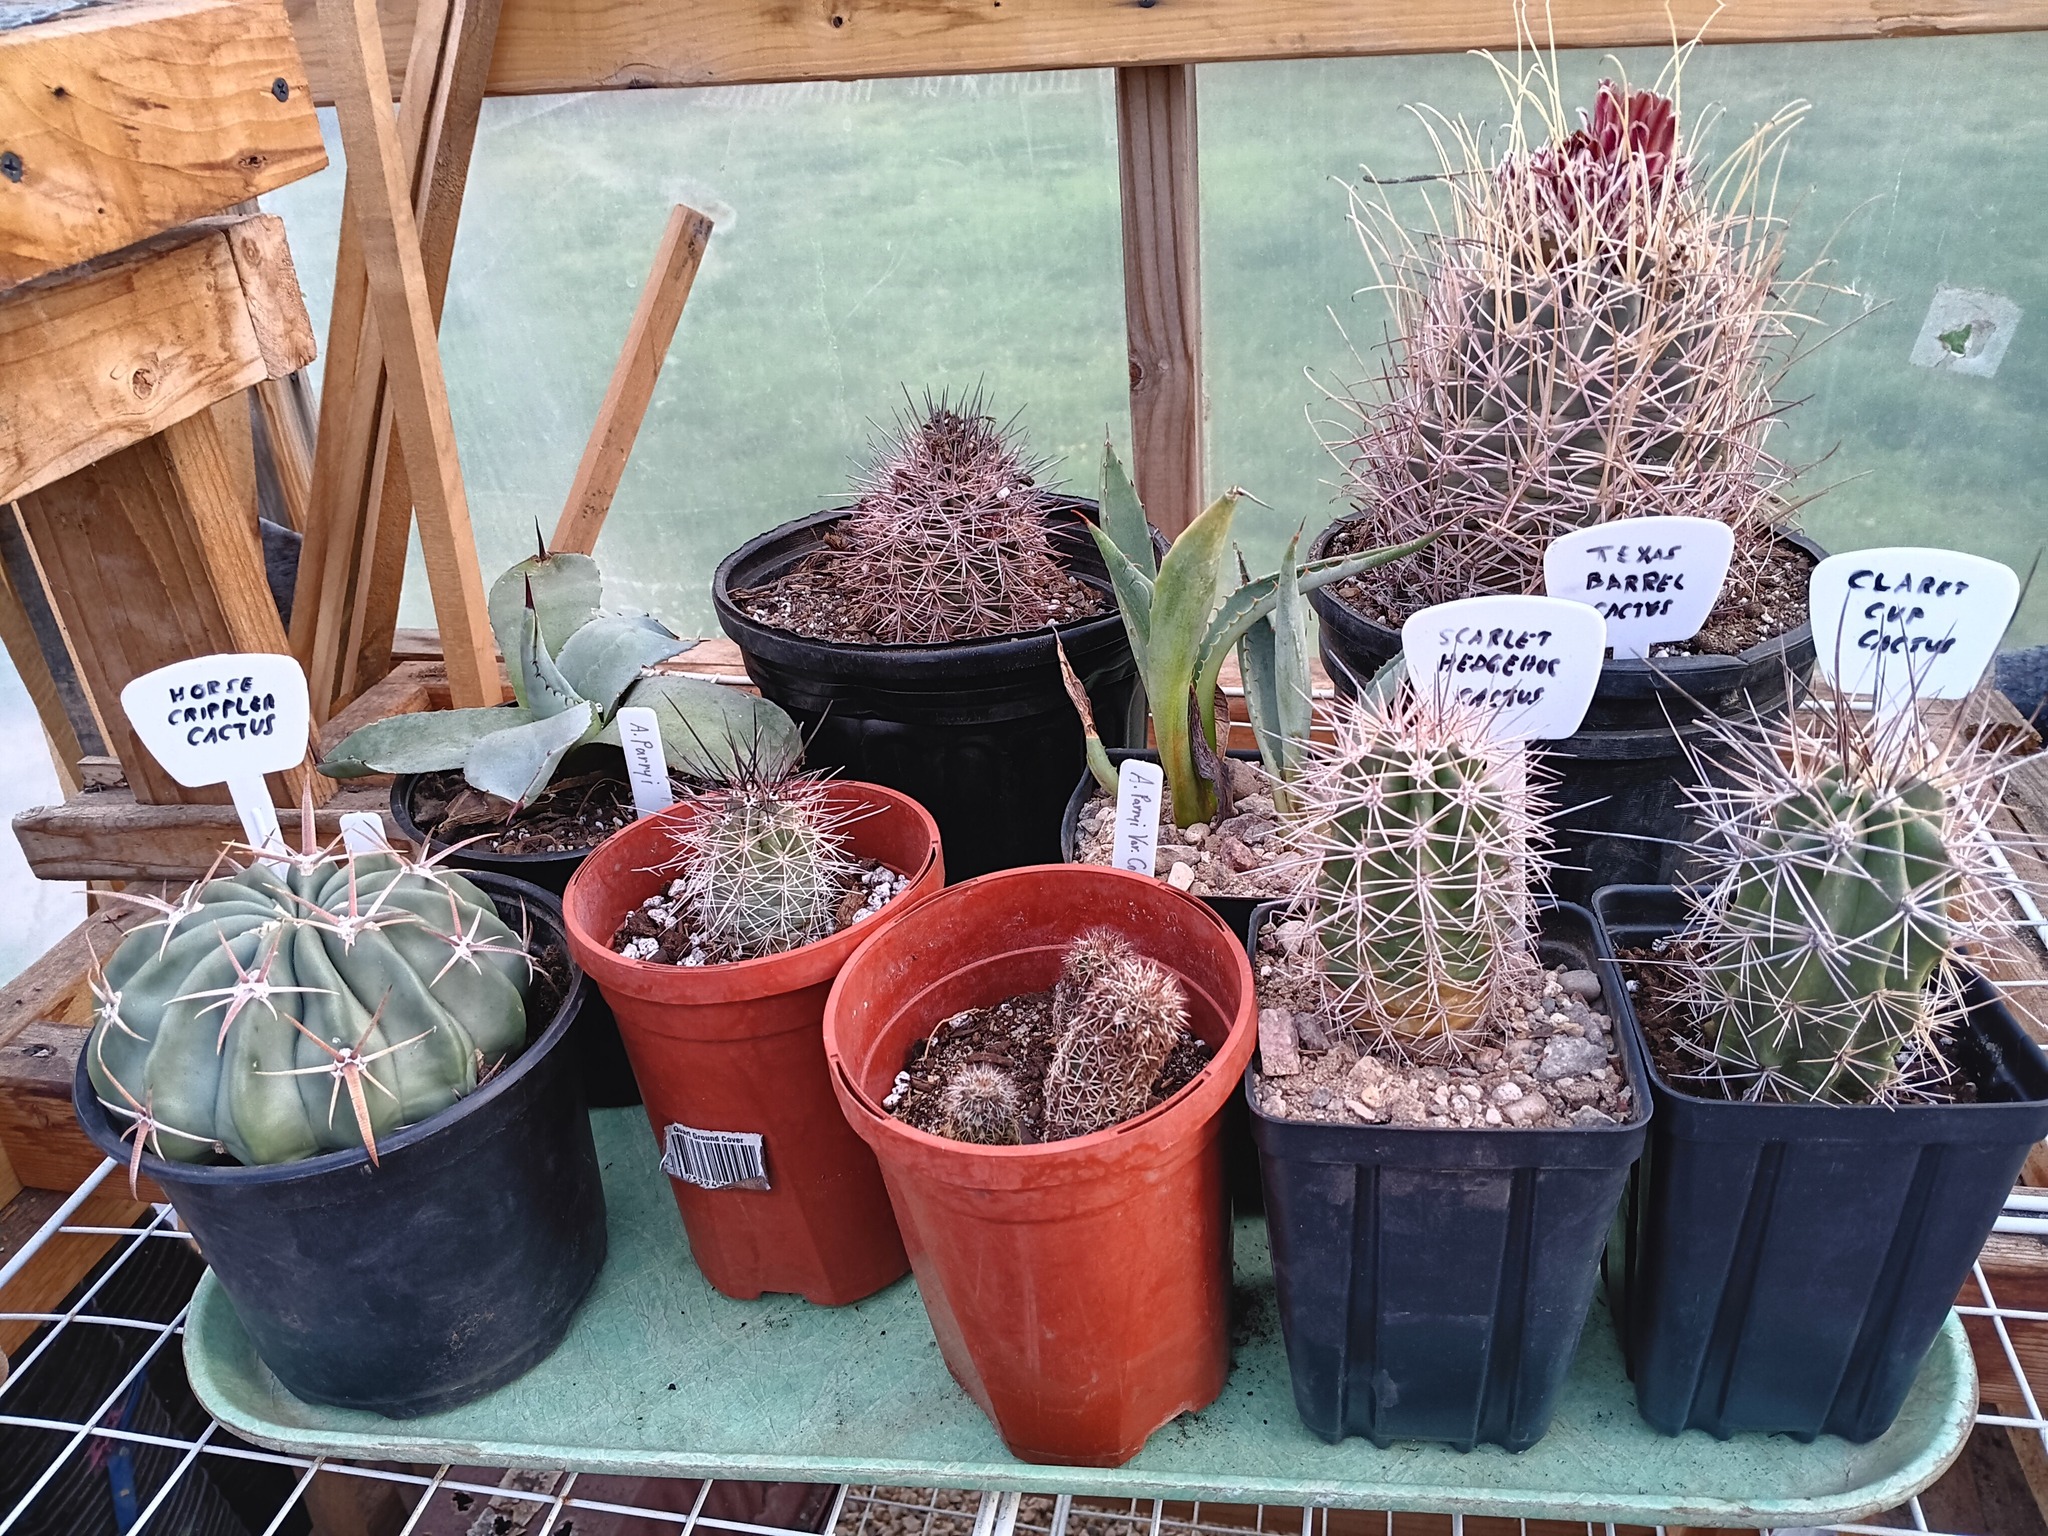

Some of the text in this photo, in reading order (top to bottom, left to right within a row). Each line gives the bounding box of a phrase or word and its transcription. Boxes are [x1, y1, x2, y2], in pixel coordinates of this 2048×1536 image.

[1586, 545, 1682, 564] TEXAS
[1586, 571, 1684, 593] BARREL
[1848, 570, 1969, 597] CLARET
[1864, 602, 1925, 625] CUP
[1439, 627, 1552, 649] SCARLET
[1857, 629, 1957, 654] CACTUS
[169, 677, 253, 703] HORSE
[168, 693, 275, 726] CRIPPLER
[187, 713, 276, 746] CACTUS
[692, 1131, 720, 1142] Ground
[721, 1135, 744, 1144] Cover
